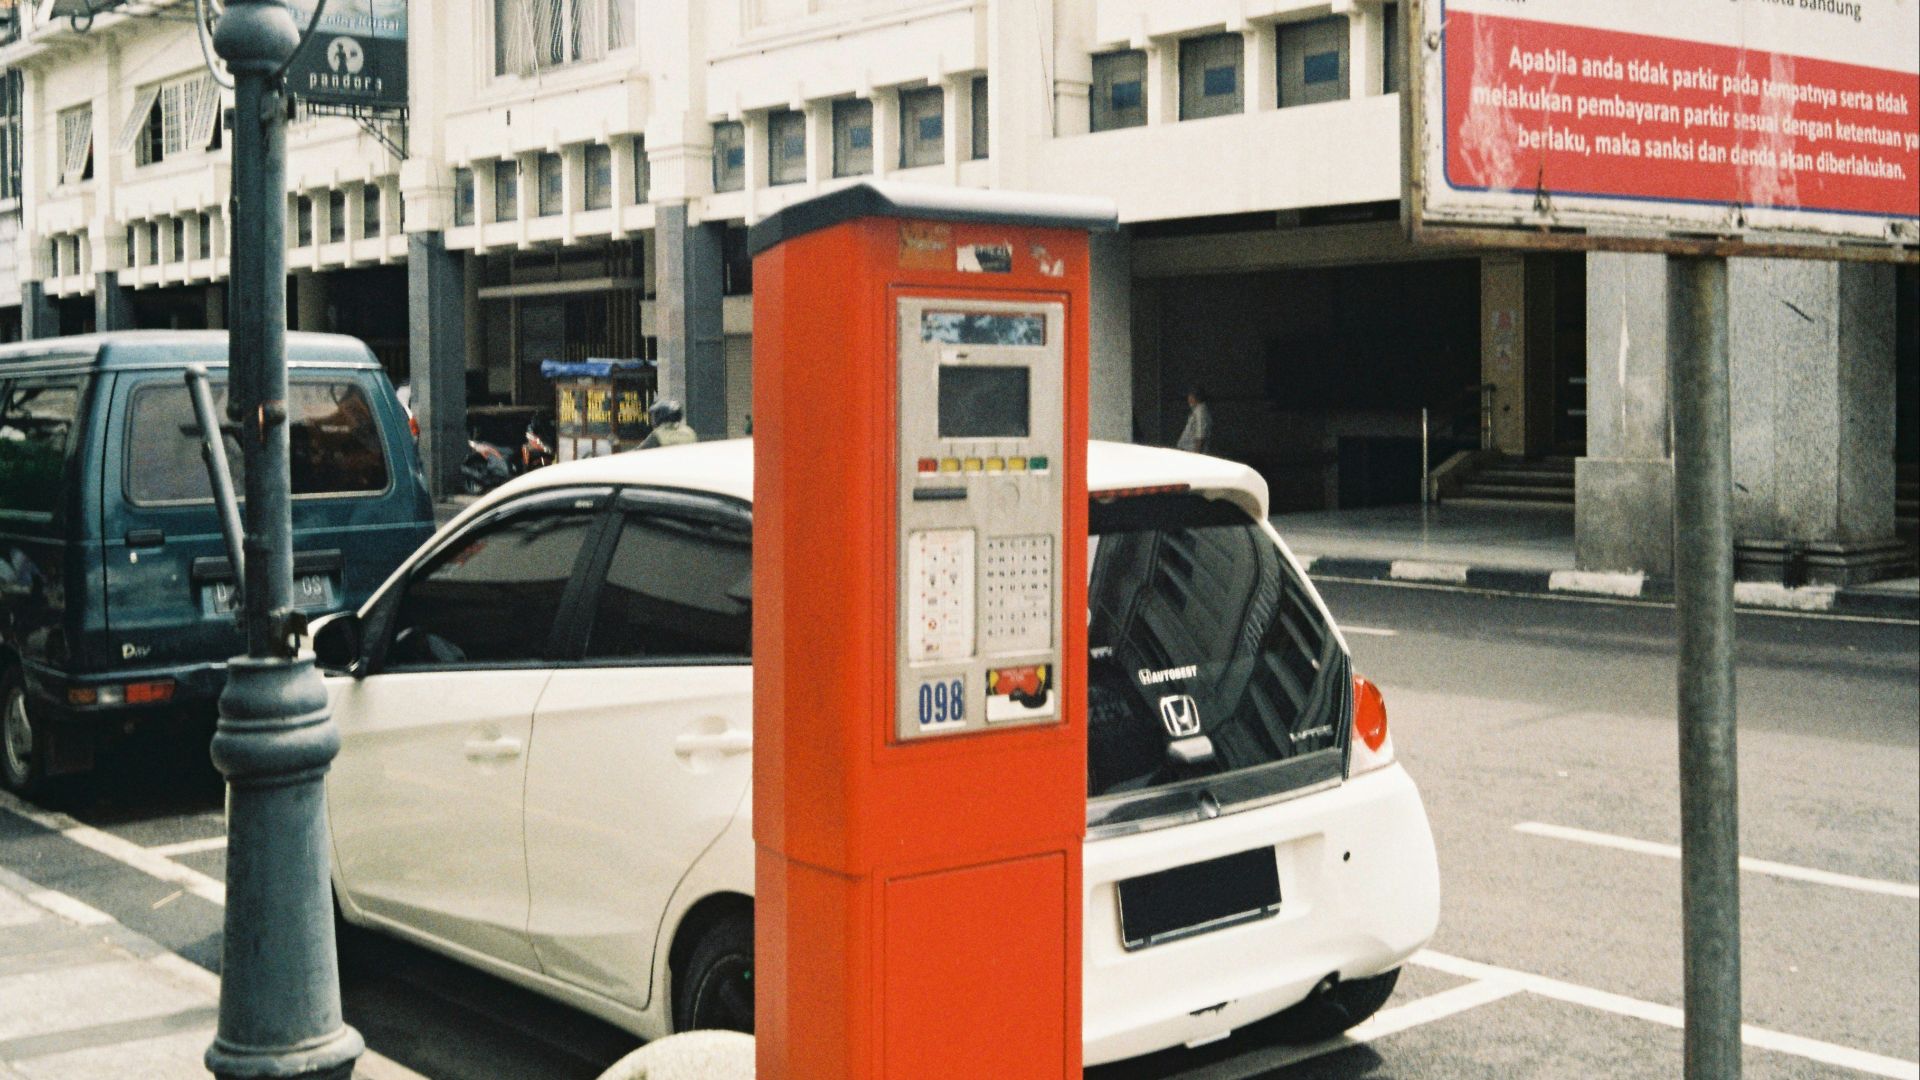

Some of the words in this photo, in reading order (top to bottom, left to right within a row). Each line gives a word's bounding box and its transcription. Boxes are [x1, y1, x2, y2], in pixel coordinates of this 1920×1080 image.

[1799, 0, 1861, 22] Bandung
[309, 72, 383, 93] pandora
[1509, 46, 1577, 75] Apabila
[1582, 56, 1623, 80] anda
[1627, 59, 1669, 85] tidak
[1673, 67, 1719, 91] parkir
[1723, 73, 1759, 96] pada
[1762, 79, 1837, 109] tempatnya
[1840, 90, 1873, 110] serta
[1876, 92, 1909, 115] tidak
[1472, 83, 1572, 113] melakukan
[1577, 94, 1680, 125] pembayaran
[1684, 104, 1730, 128] parkir
[1782, 113, 1832, 142] dengan
[1836, 119, 1901, 147] ketentuan
[1518, 124, 1590, 156] berlaku,
[1595, 132, 1640, 156] maka
[1645, 136, 1694, 160] sanksi
[1698, 140, 1726, 163] dan
[1730, 142, 1776, 167] denda
[1780, 149, 1813, 171] akan
[1817, 151, 1906, 180] diberlakukan.
[919, 680, 963, 724] 098
